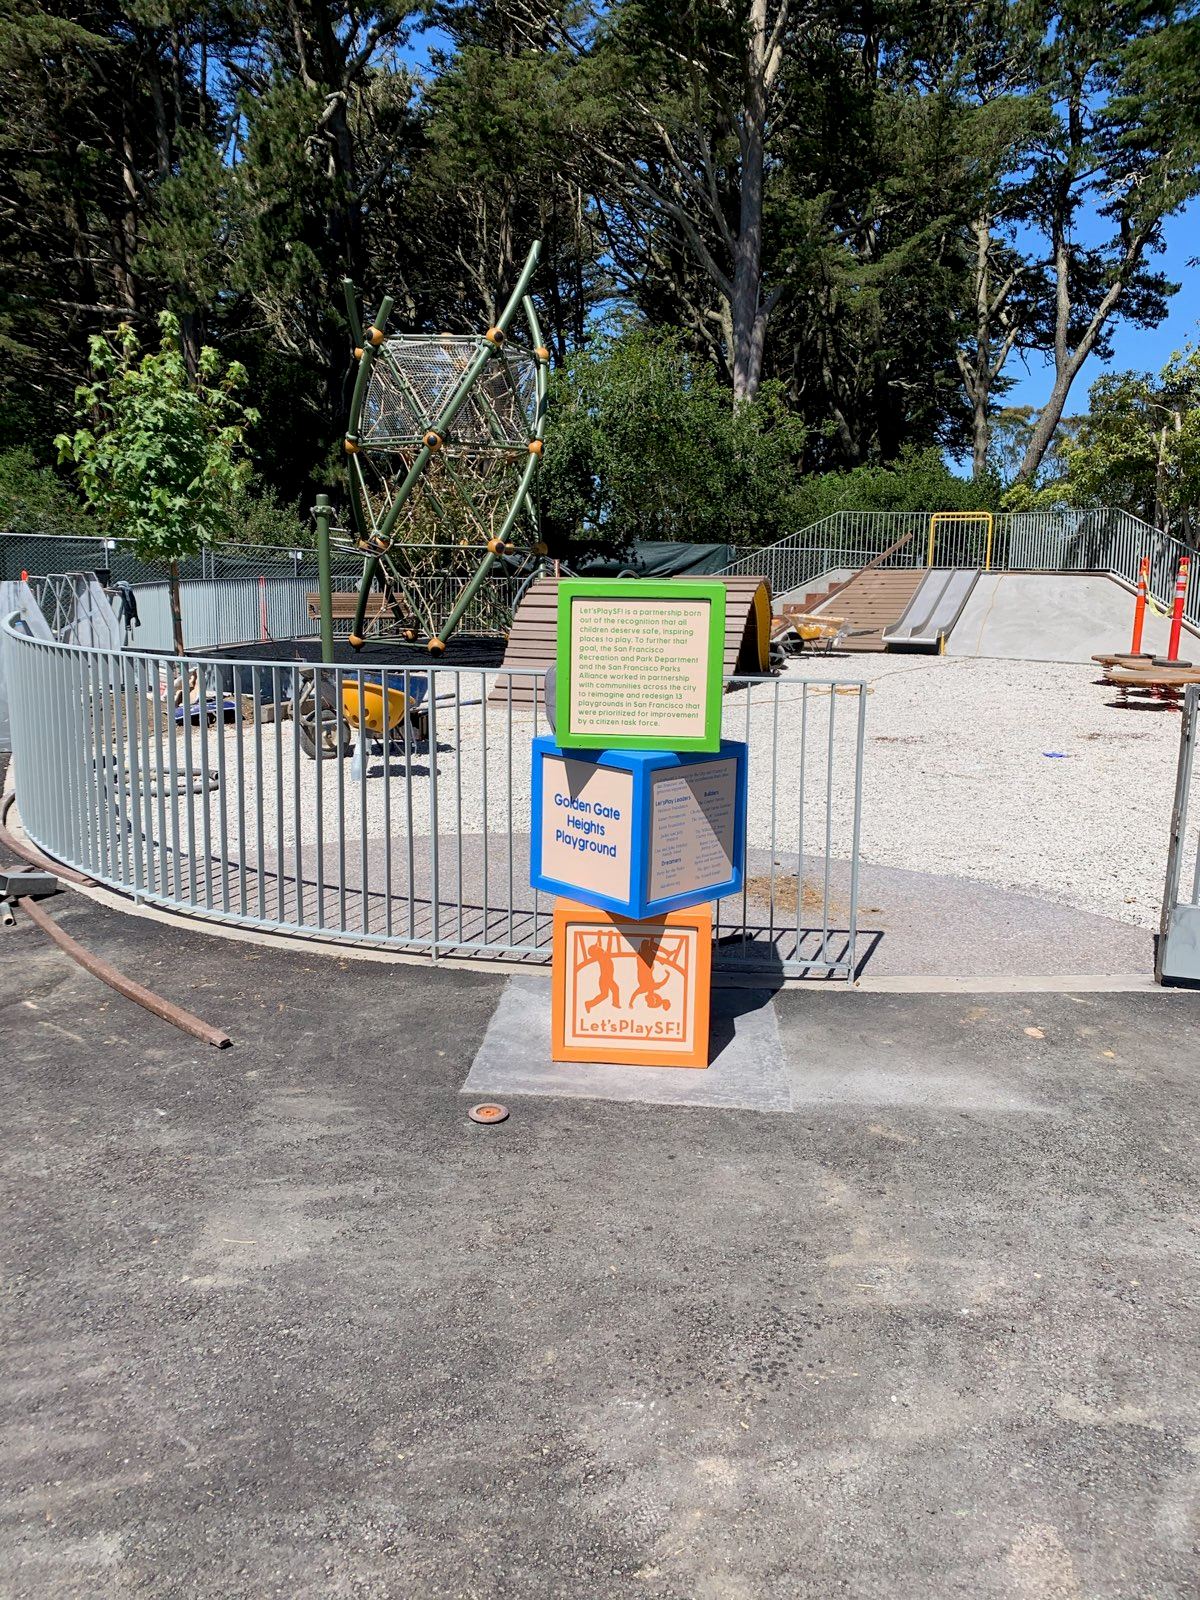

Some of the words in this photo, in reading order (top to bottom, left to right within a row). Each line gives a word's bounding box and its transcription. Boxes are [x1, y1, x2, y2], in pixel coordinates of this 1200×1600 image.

[648, 674, 690, 682] partnership
[554, 794, 591, 813] Golden
[594, 803, 621, 820] Gate
[567, 814, 606, 836] Heights
[556, 830, 616, 858] Playground
[580, 1018, 680, 1038] Let'sPlaySF!
